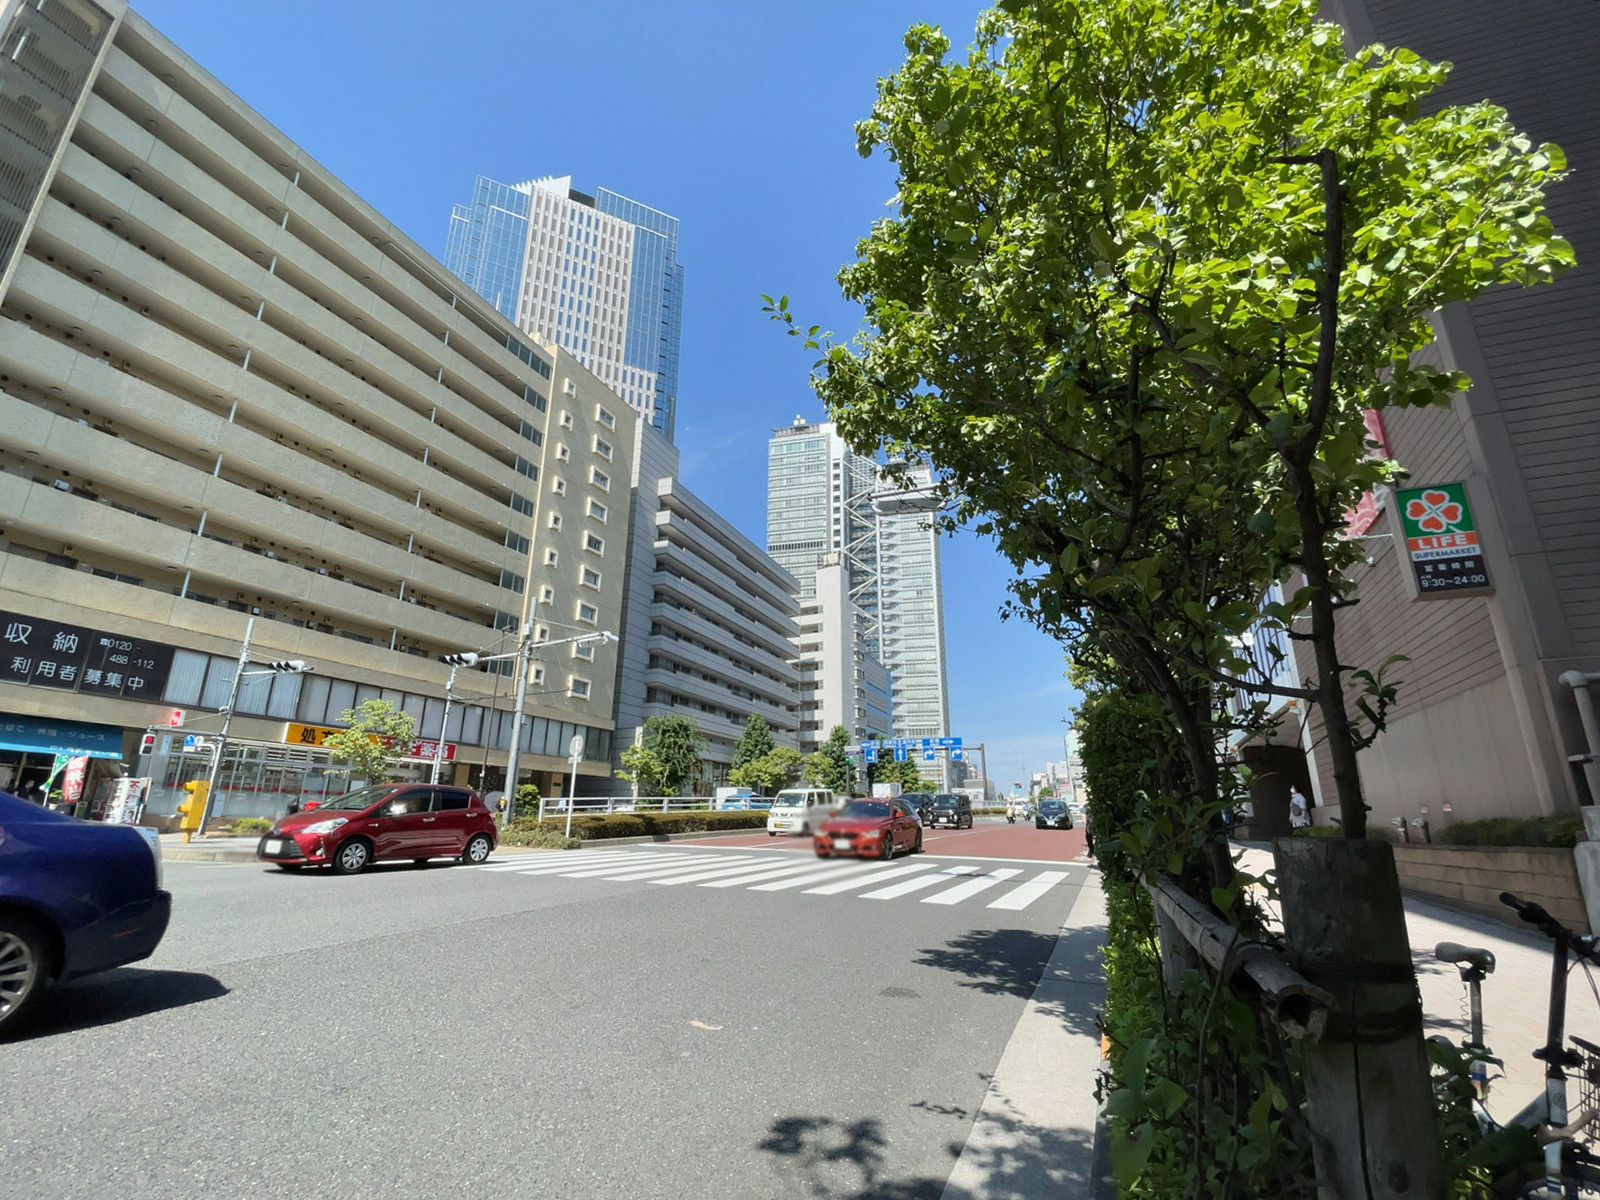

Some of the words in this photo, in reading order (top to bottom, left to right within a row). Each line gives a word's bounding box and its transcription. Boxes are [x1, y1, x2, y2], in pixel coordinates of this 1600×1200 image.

[1418, 534, 1467, 549] LIFE
[1415, 547, 1477, 559] SUPERMARKET
[10, 656, 144, 691] 利用者募集中
[68, 731, 105, 741] ジュース
